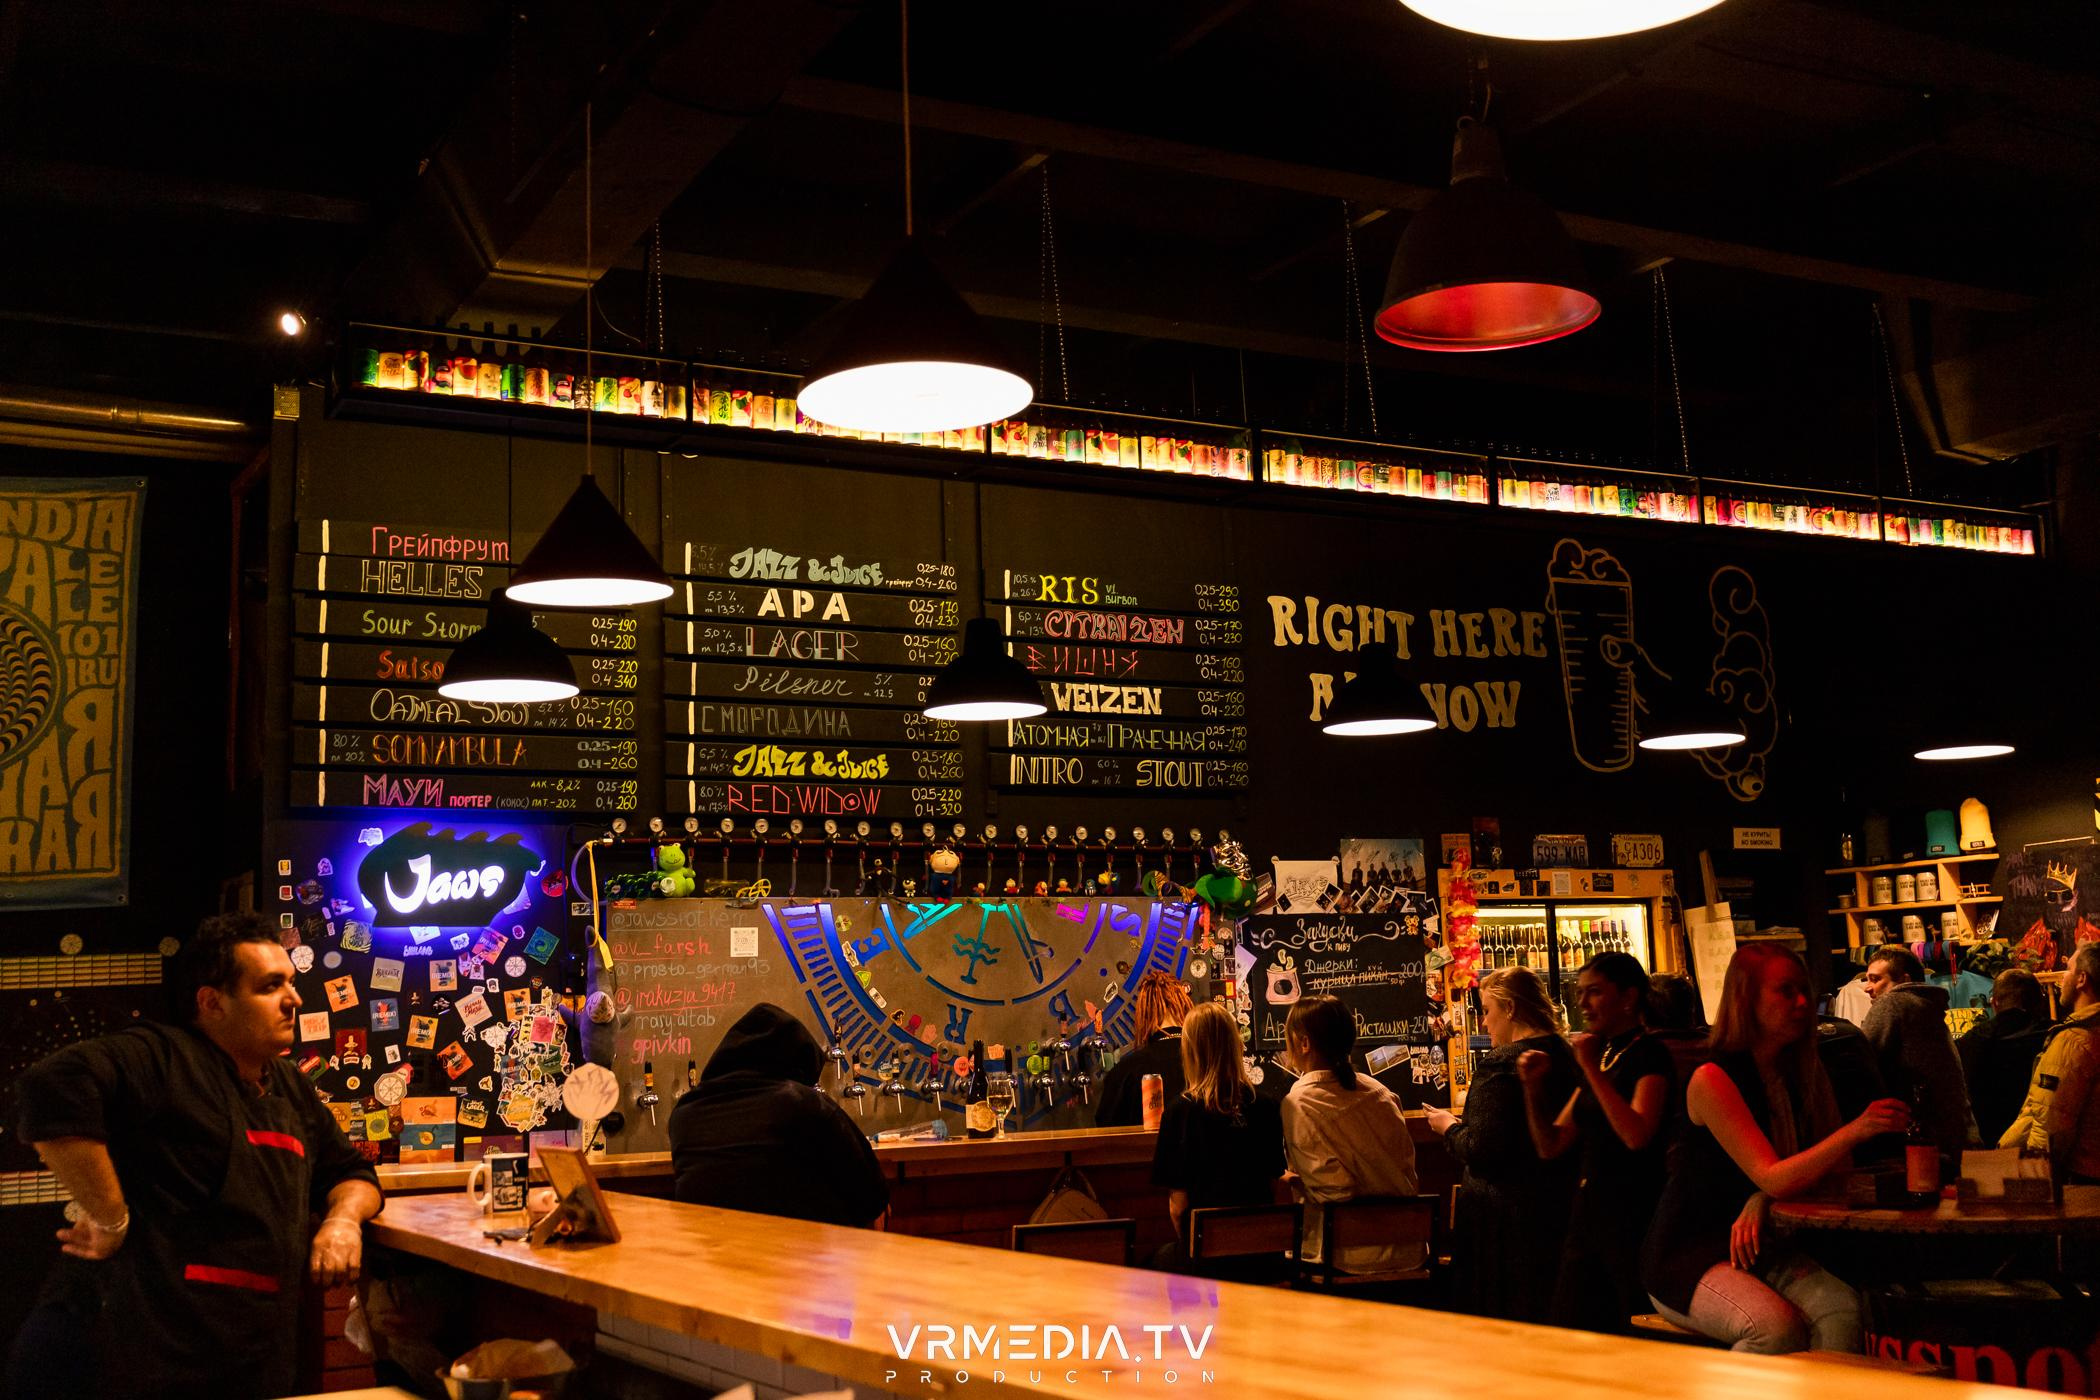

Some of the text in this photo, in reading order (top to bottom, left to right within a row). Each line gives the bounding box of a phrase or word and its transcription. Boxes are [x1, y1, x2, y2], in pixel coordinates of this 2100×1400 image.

[361, 560, 484, 599] HELLES
[728, 547, 801, 580] JAZZ
[1035, 574, 1100, 605] RIS
[361, 609, 414, 635] Sour
[1266, 595, 1548, 660] RIGHT HERE
[745, 627, 861, 661] LAGER
[376, 650, 445, 681] Saiso
[734, 666, 853, 696] Pilsner
[1050, 682, 1163, 715] WEIZEN
[701, 705, 851, 736] СМОРОДИНА
[1014, 720, 1206, 751] АТОМНАЯ ПРАЧЕЧНАЯ
[733, 745, 807, 778] JAZZ
[1136, 760, 1205, 787] STOUT
[363, 774, 445, 807] МАУИ
[449, 794, 492, 808] ПОРТЕР
[728, 784, 792, 814] RED
[384, 853, 505, 914] Jaws
